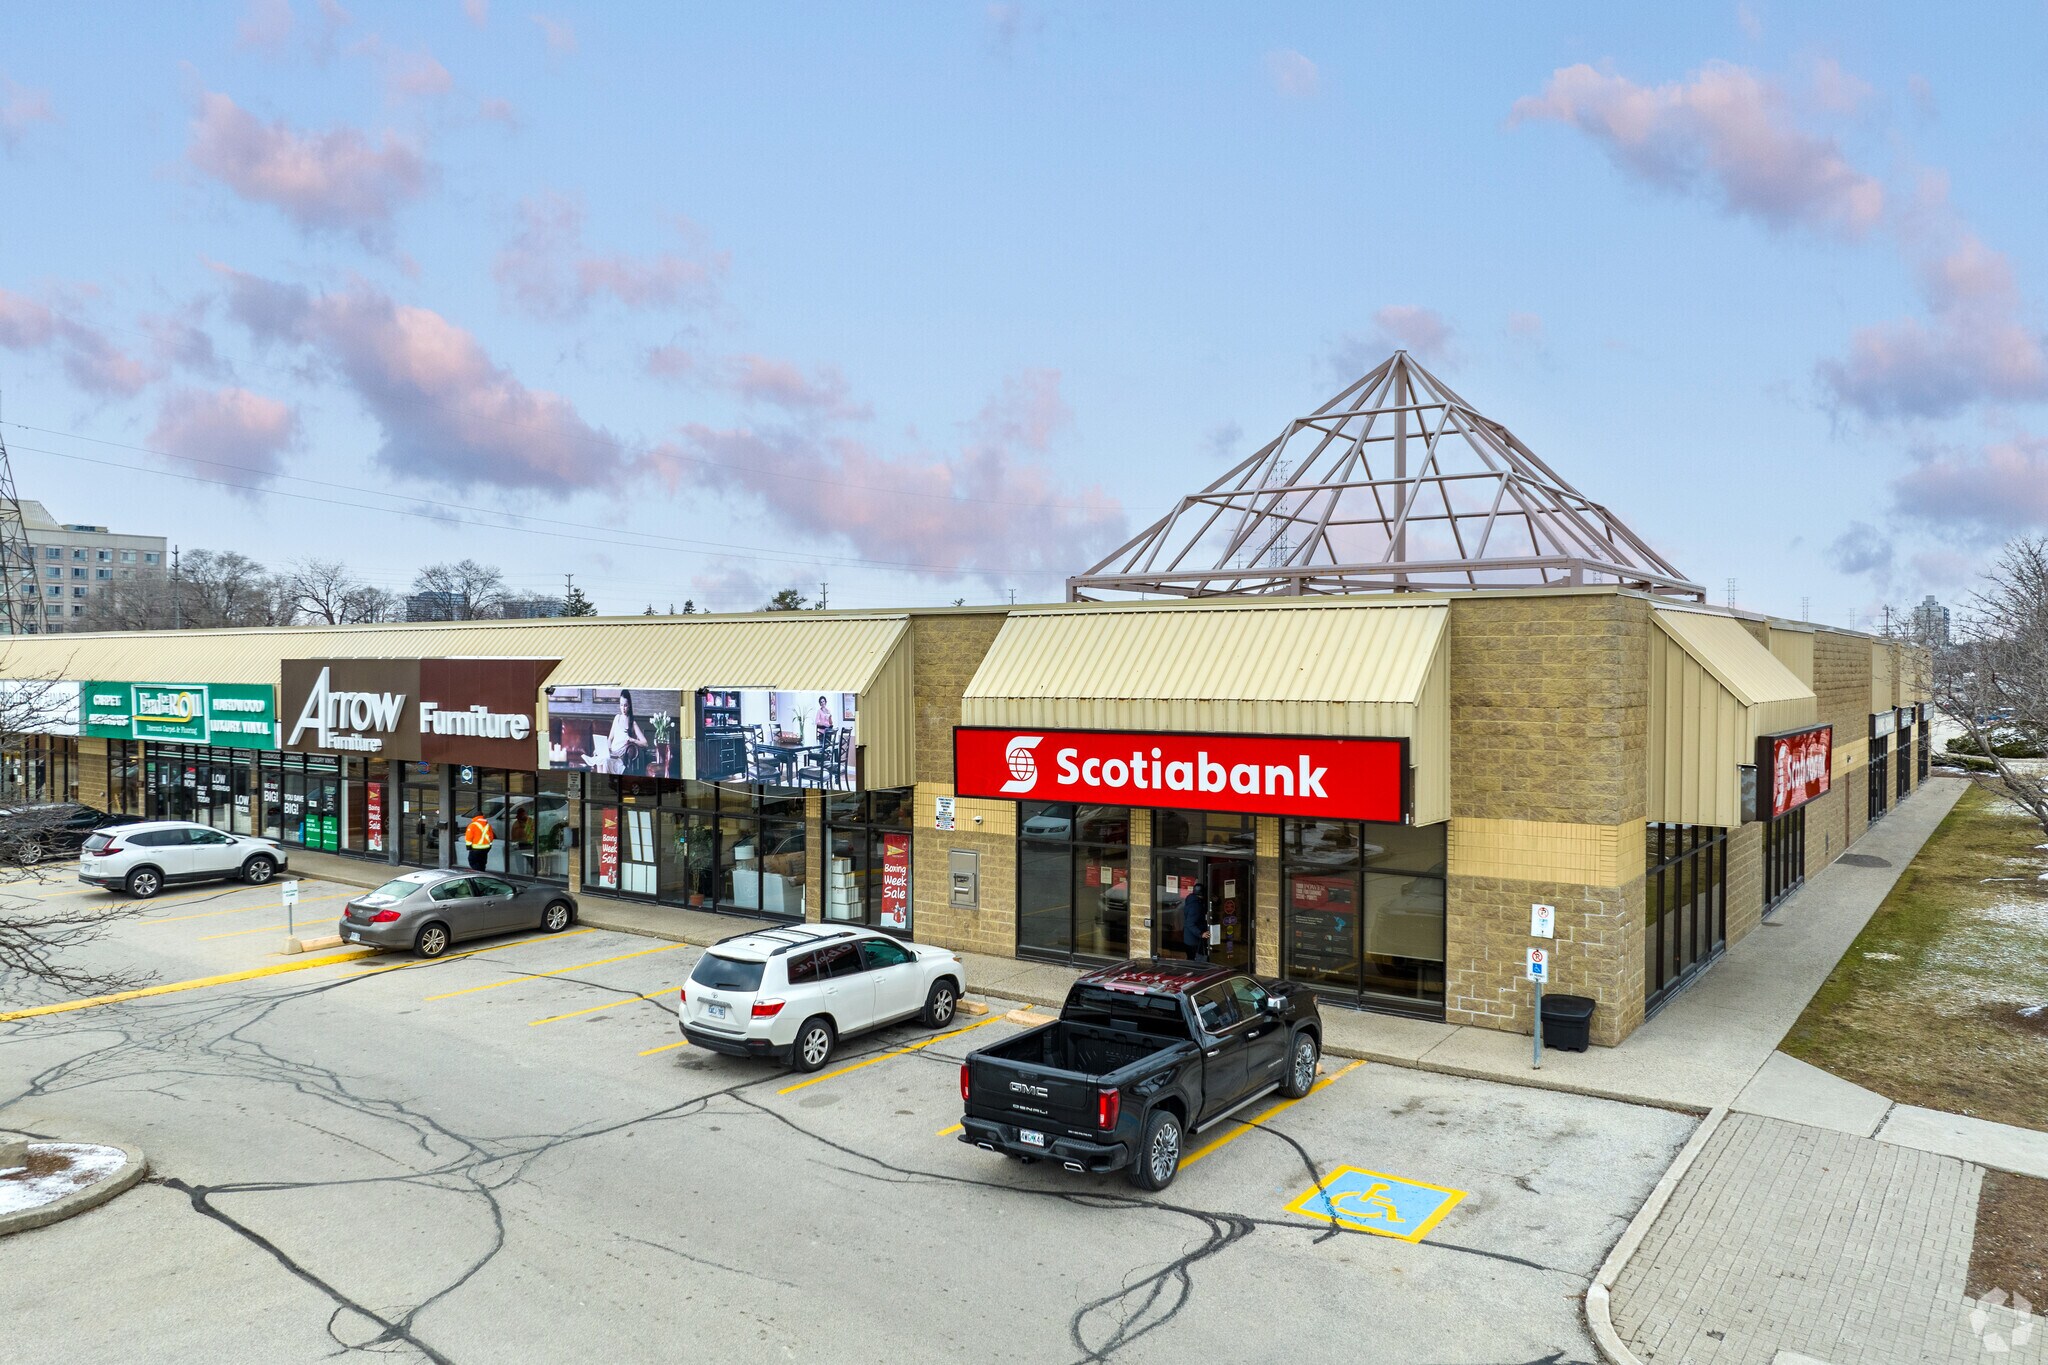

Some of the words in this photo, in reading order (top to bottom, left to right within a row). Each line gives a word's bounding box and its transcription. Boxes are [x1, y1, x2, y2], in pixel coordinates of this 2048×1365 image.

[212, 698, 265, 712] HARDWOOD
[287, 666, 407, 748] Arrow
[210, 719, 242, 732] LUXURY
[242, 720, 271, 735] VINYL
[419, 702, 530, 740] Furniture
[163, 725, 176, 734] Carpet
[180, 726, 198, 736] Flooring
[326, 731, 383, 753] Furniture
[212, 774, 226, 784] LOW
[1056, 747, 1329, 799] Scotiabank
[234, 794, 250, 806] LOW
[263, 790, 279, 803] BIG!
[284, 793, 294, 801] YOU
[294, 794, 304, 802] SAVE
[284, 802, 299, 815] BIG!
[368, 804, 381, 813] Boxing
[368, 821, 381, 830] Sale
[602, 834, 617, 842] Boxing
[602, 844, 618, 853] Week
[601, 853, 617, 864] Sale
[884, 864, 907, 876] Boxing
[884, 875, 907, 887] Week
[883, 886, 906, 899] Sale
[1009, 1081, 1049, 1098] GMC
[1012, 1103, 1048, 1115] DENALI
